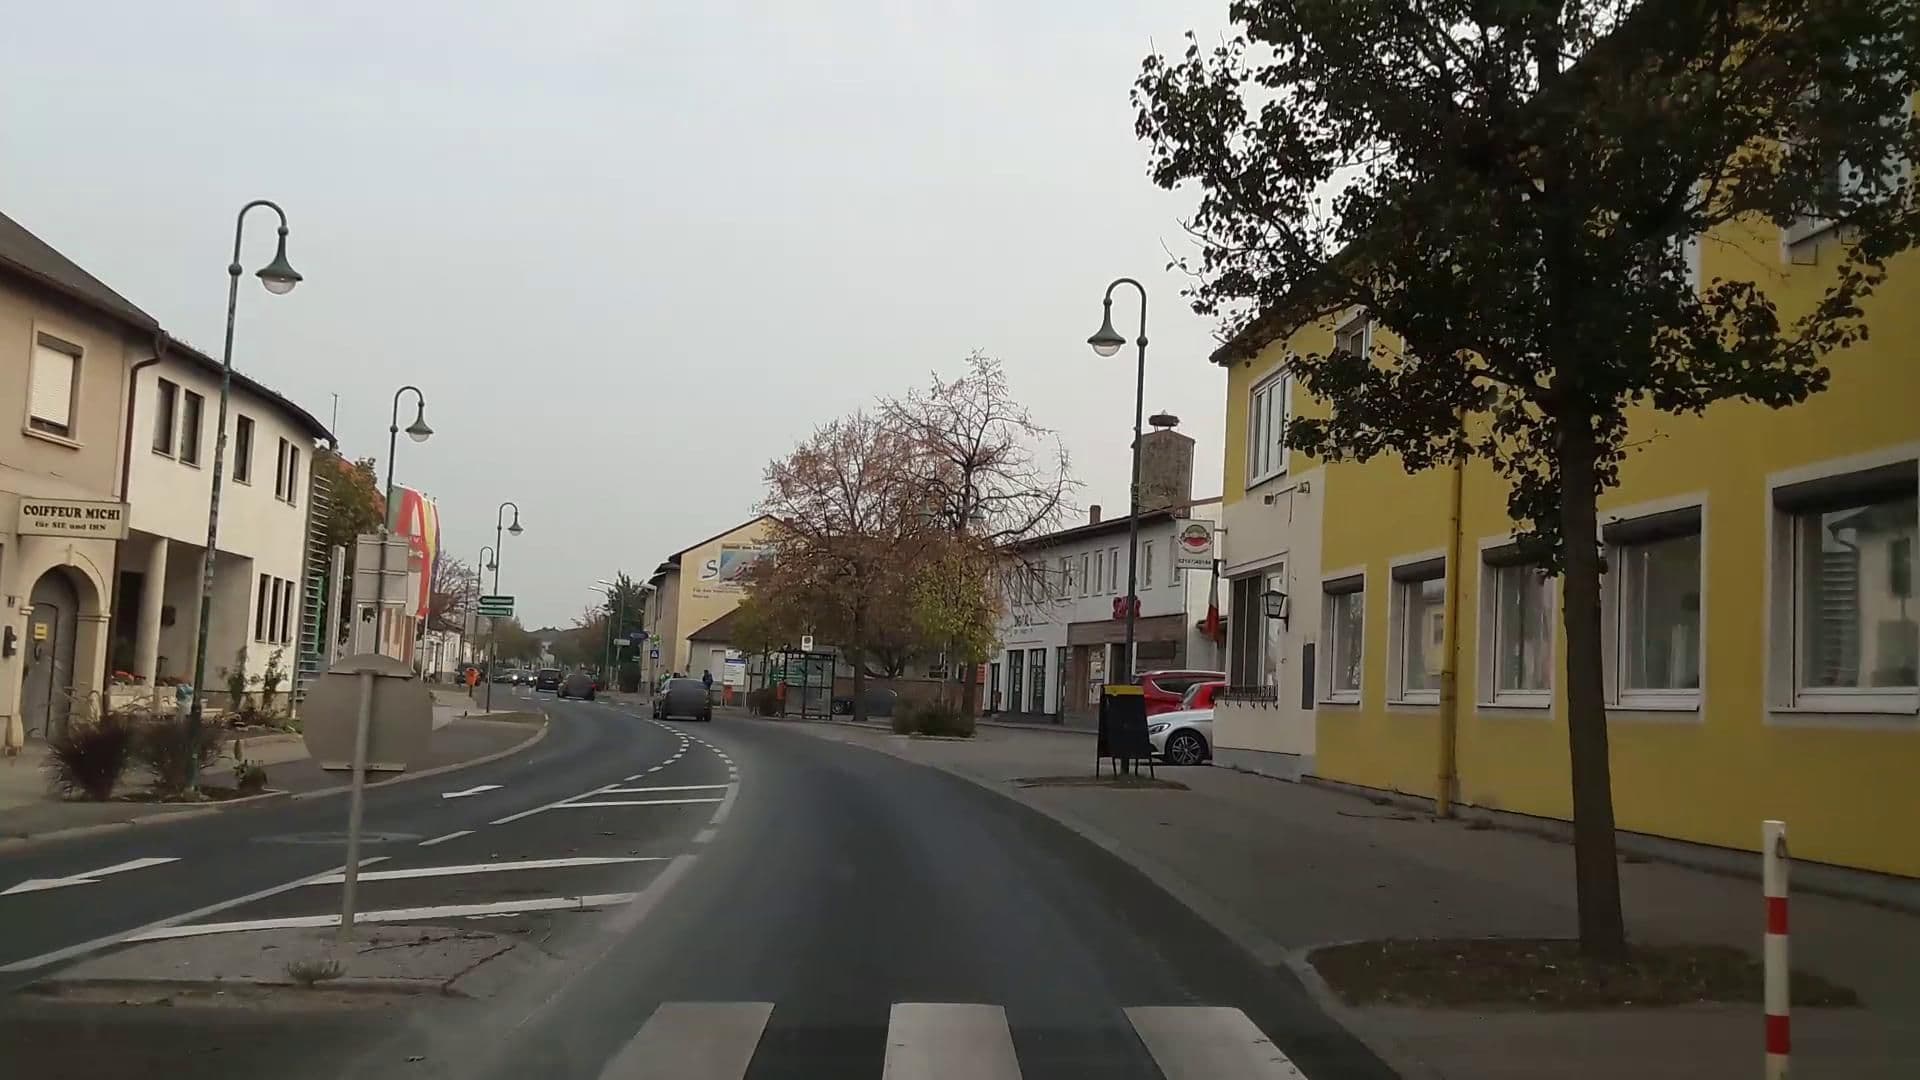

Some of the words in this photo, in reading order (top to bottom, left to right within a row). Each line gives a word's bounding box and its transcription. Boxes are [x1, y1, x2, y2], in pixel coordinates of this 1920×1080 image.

[23, 505, 82, 518] COIFFEUR
[85, 508, 120, 520] MICHI
[52, 521, 66, 529] SIE
